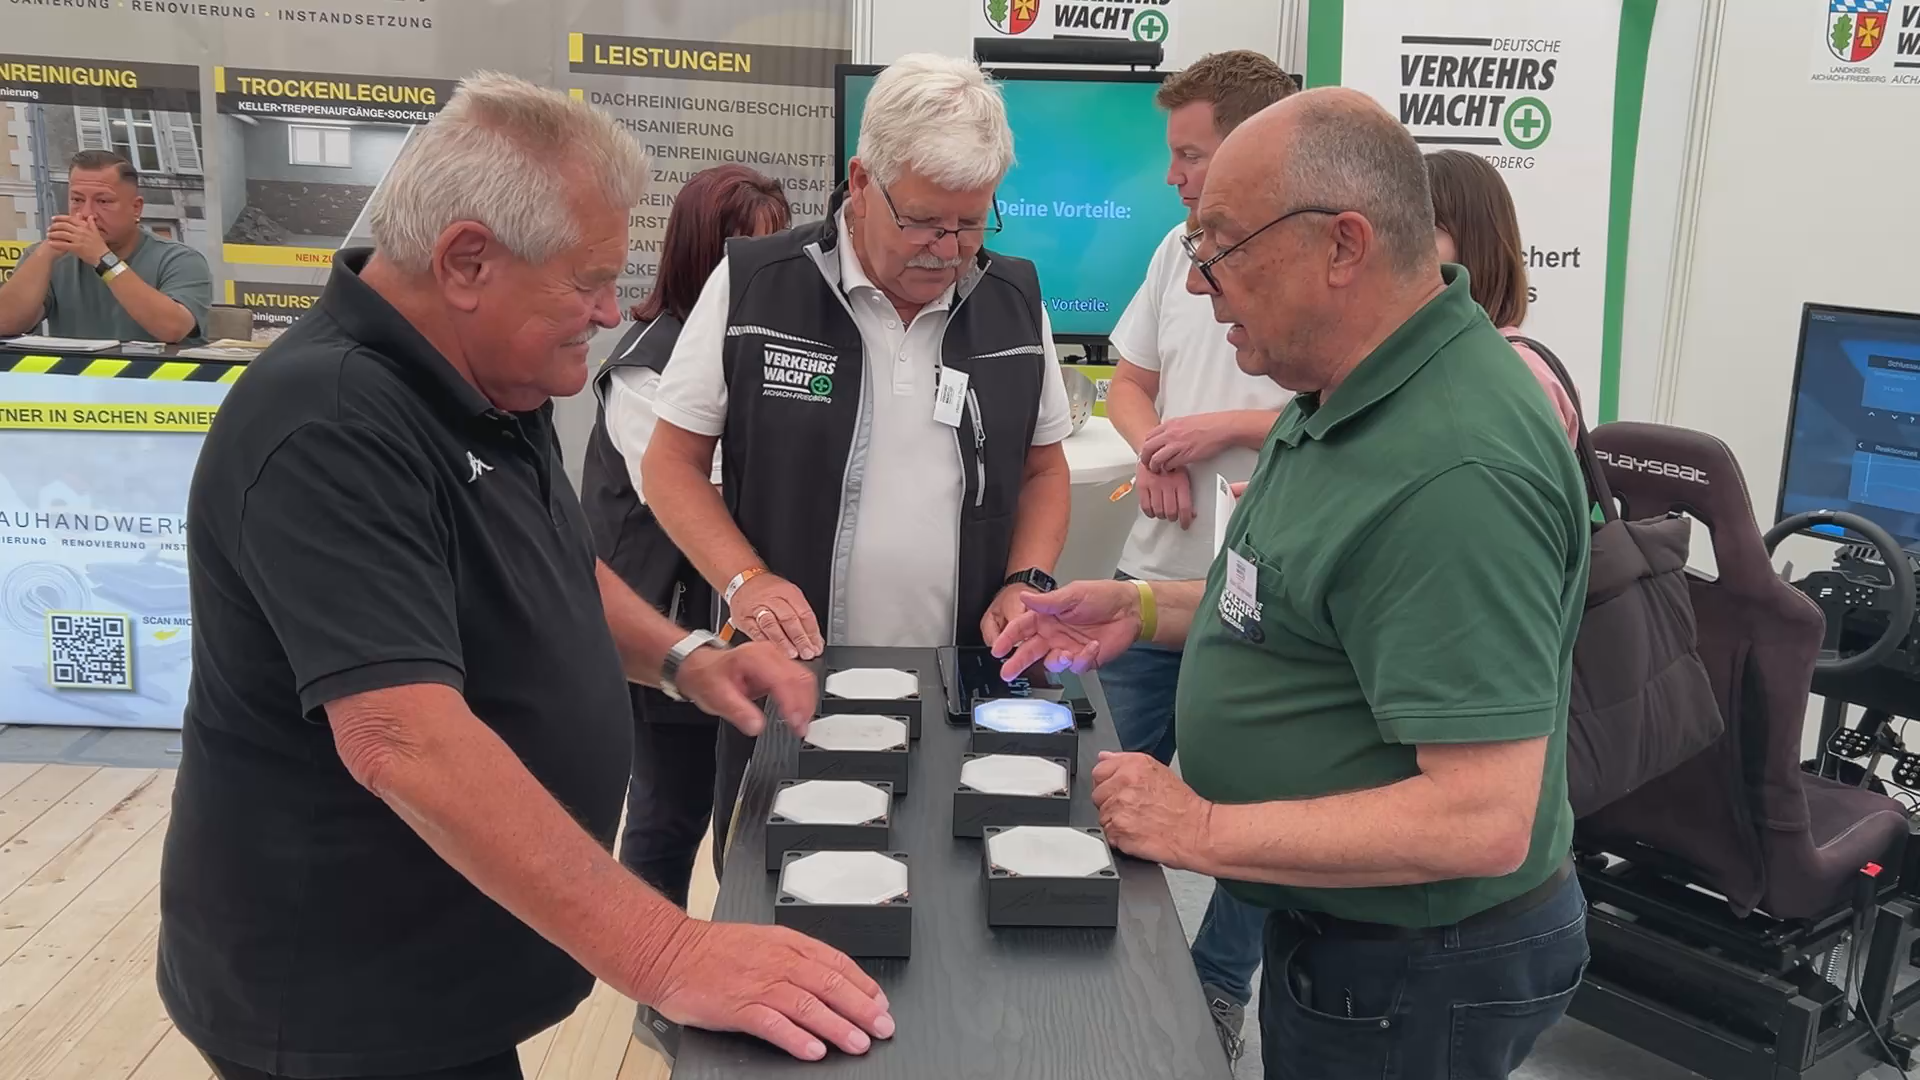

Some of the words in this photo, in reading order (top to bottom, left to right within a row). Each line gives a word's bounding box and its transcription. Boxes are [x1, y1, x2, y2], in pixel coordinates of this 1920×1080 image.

[132, 0, 256, 18] RENOVIERUNG
[278, 10, 432, 28] INSTANDSETZUNG
[1054, 4, 1135, 31] WACHT
[1493, 38, 1561, 53] DEUTSCHE
[595, 44, 751, 73] LEISTUNGEN
[1400, 54, 1557, 91] VERKEHRS
[237, 77, 436, 105] TROCKENLEGUNG
[1399, 93, 1506, 127] WACHT
[997, 198, 1048, 217] Deine
[1052, 200, 1132, 219] Vorteile:
[296, 253, 320, 262] NEIN
[1051, 298, 1109, 312] Vorteile:
[764, 350, 836, 375] VERKEHRS
[764, 366, 813, 386] WACHT
[49, 410, 67, 422] IN
[73, 410, 147, 424] SACHEN
[2, 536, 46, 545] IERUNG
[62, 539, 146, 549] RENOVIERUNG
[142, 616, 171, 625] SCAN
